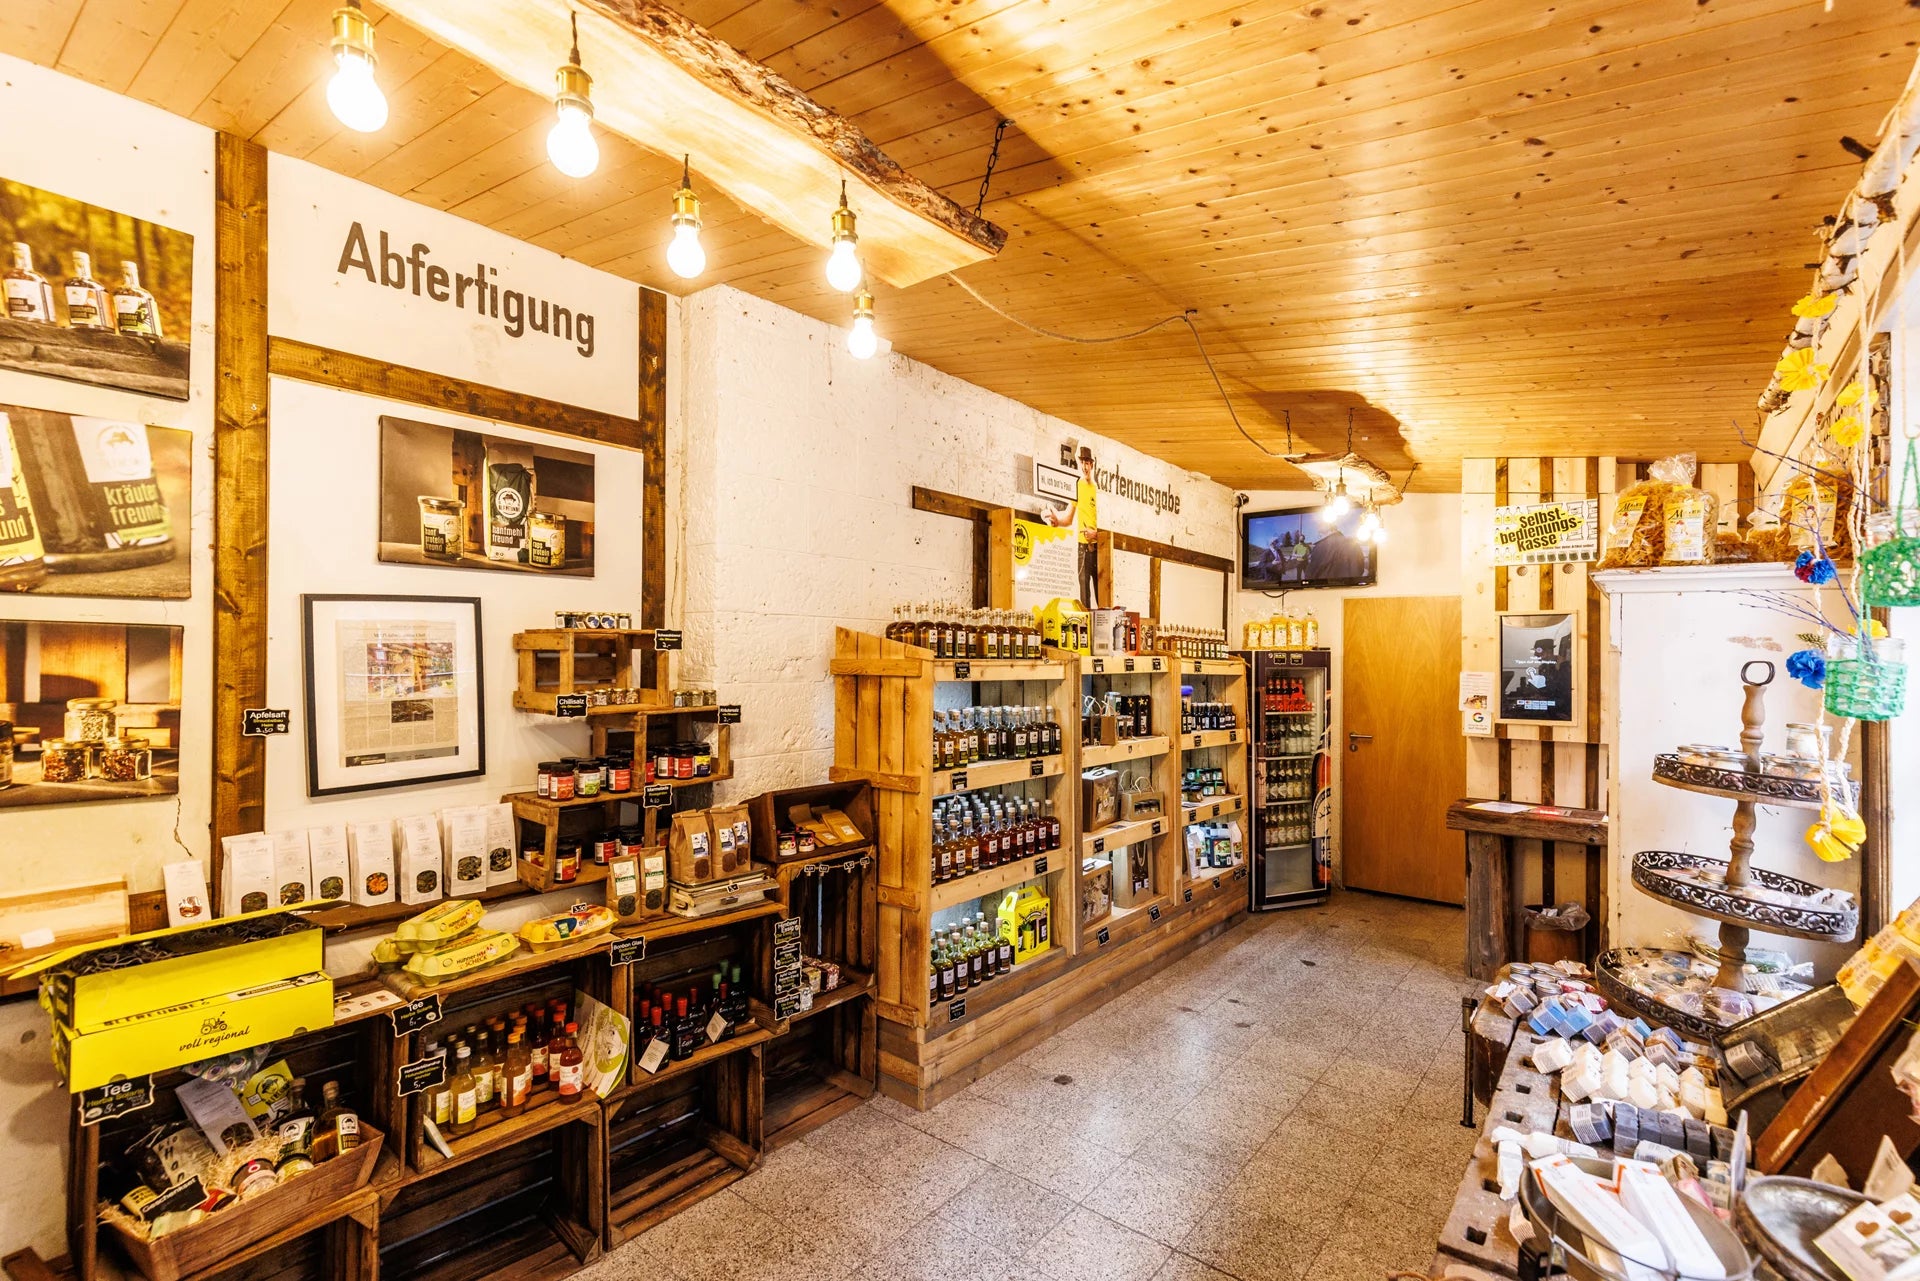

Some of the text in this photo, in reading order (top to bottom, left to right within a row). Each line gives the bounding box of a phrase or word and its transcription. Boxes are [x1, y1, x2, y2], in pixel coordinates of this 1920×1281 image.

[337, 221, 595, 358] Abfertigung
[1519, 507, 1566, 529] Selbst-
[491, 534, 514, 545] freund
[1499, 517, 1583, 545] bedienungs-
[1516, 533, 1558, 552] kasse
[249, 711, 287, 720] Apfelsaft
[408, 1001, 424, 1011] Tee
[178, 1025, 251, 1052] voll regional
[100, 1082, 133, 1098] Tee
